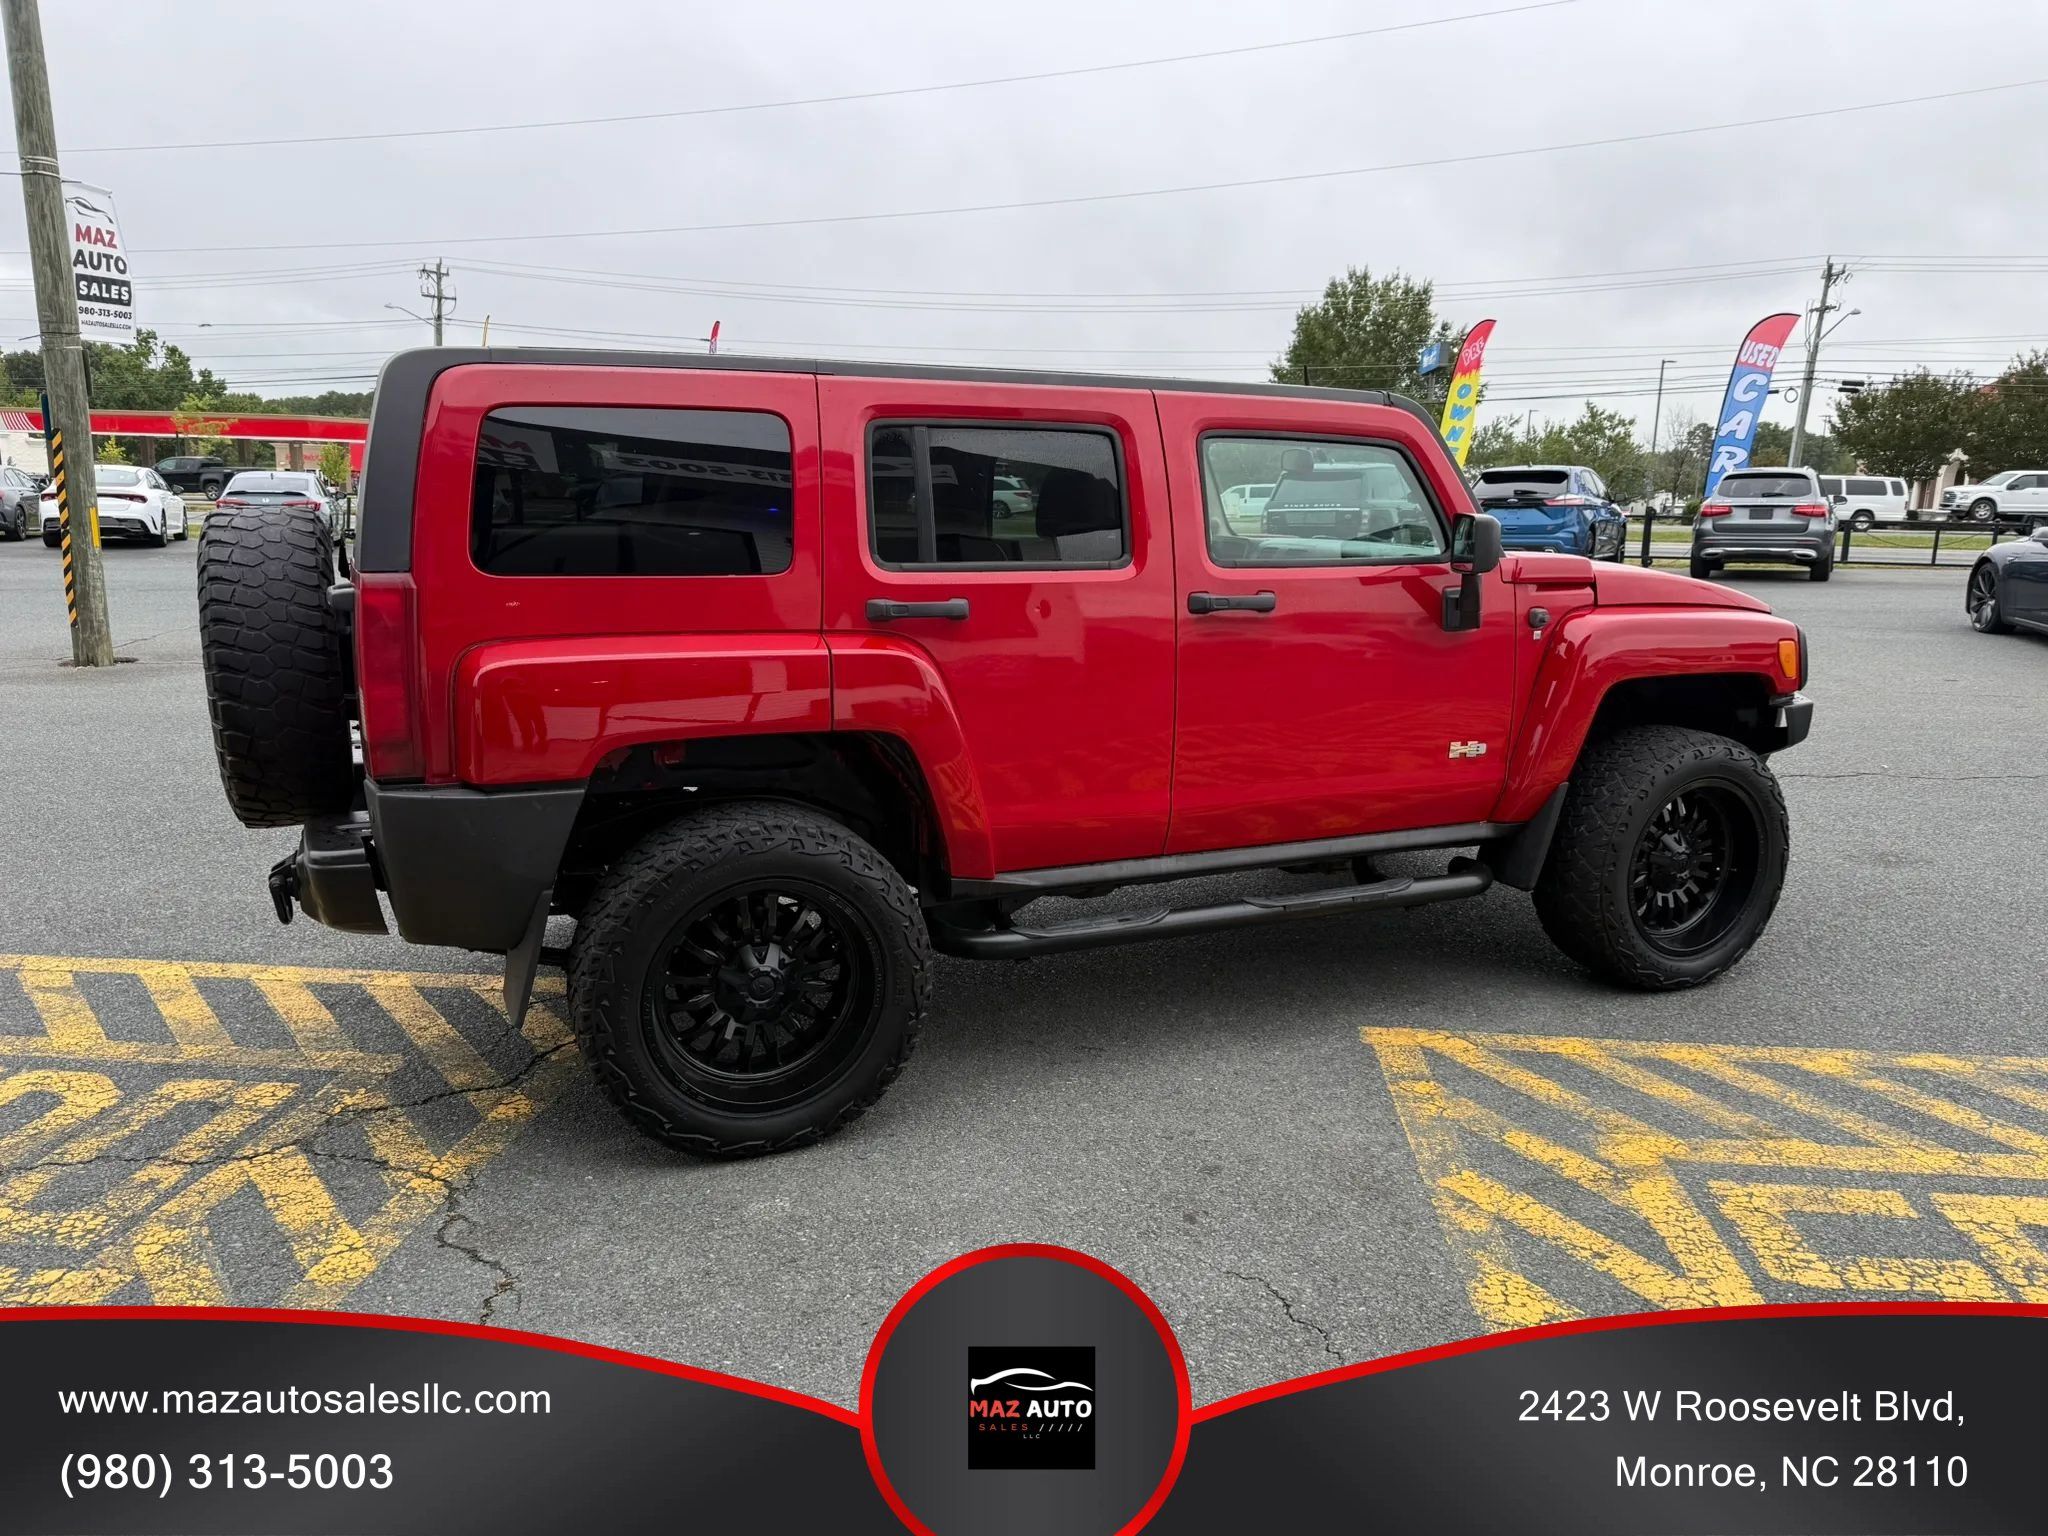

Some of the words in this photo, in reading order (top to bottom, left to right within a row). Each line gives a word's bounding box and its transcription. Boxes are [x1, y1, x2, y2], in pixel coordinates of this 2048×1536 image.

[75, 223, 118, 250] MAZ
[73, 249, 127, 275] AUTO
[79, 281, 130, 301] SALES
[78, 305, 133, 320] 980-313-5003
[1461, 336, 1486, 367] PRE
[1739, 340, 1781, 369] USED
[1711, 373, 1768, 491] CAR
